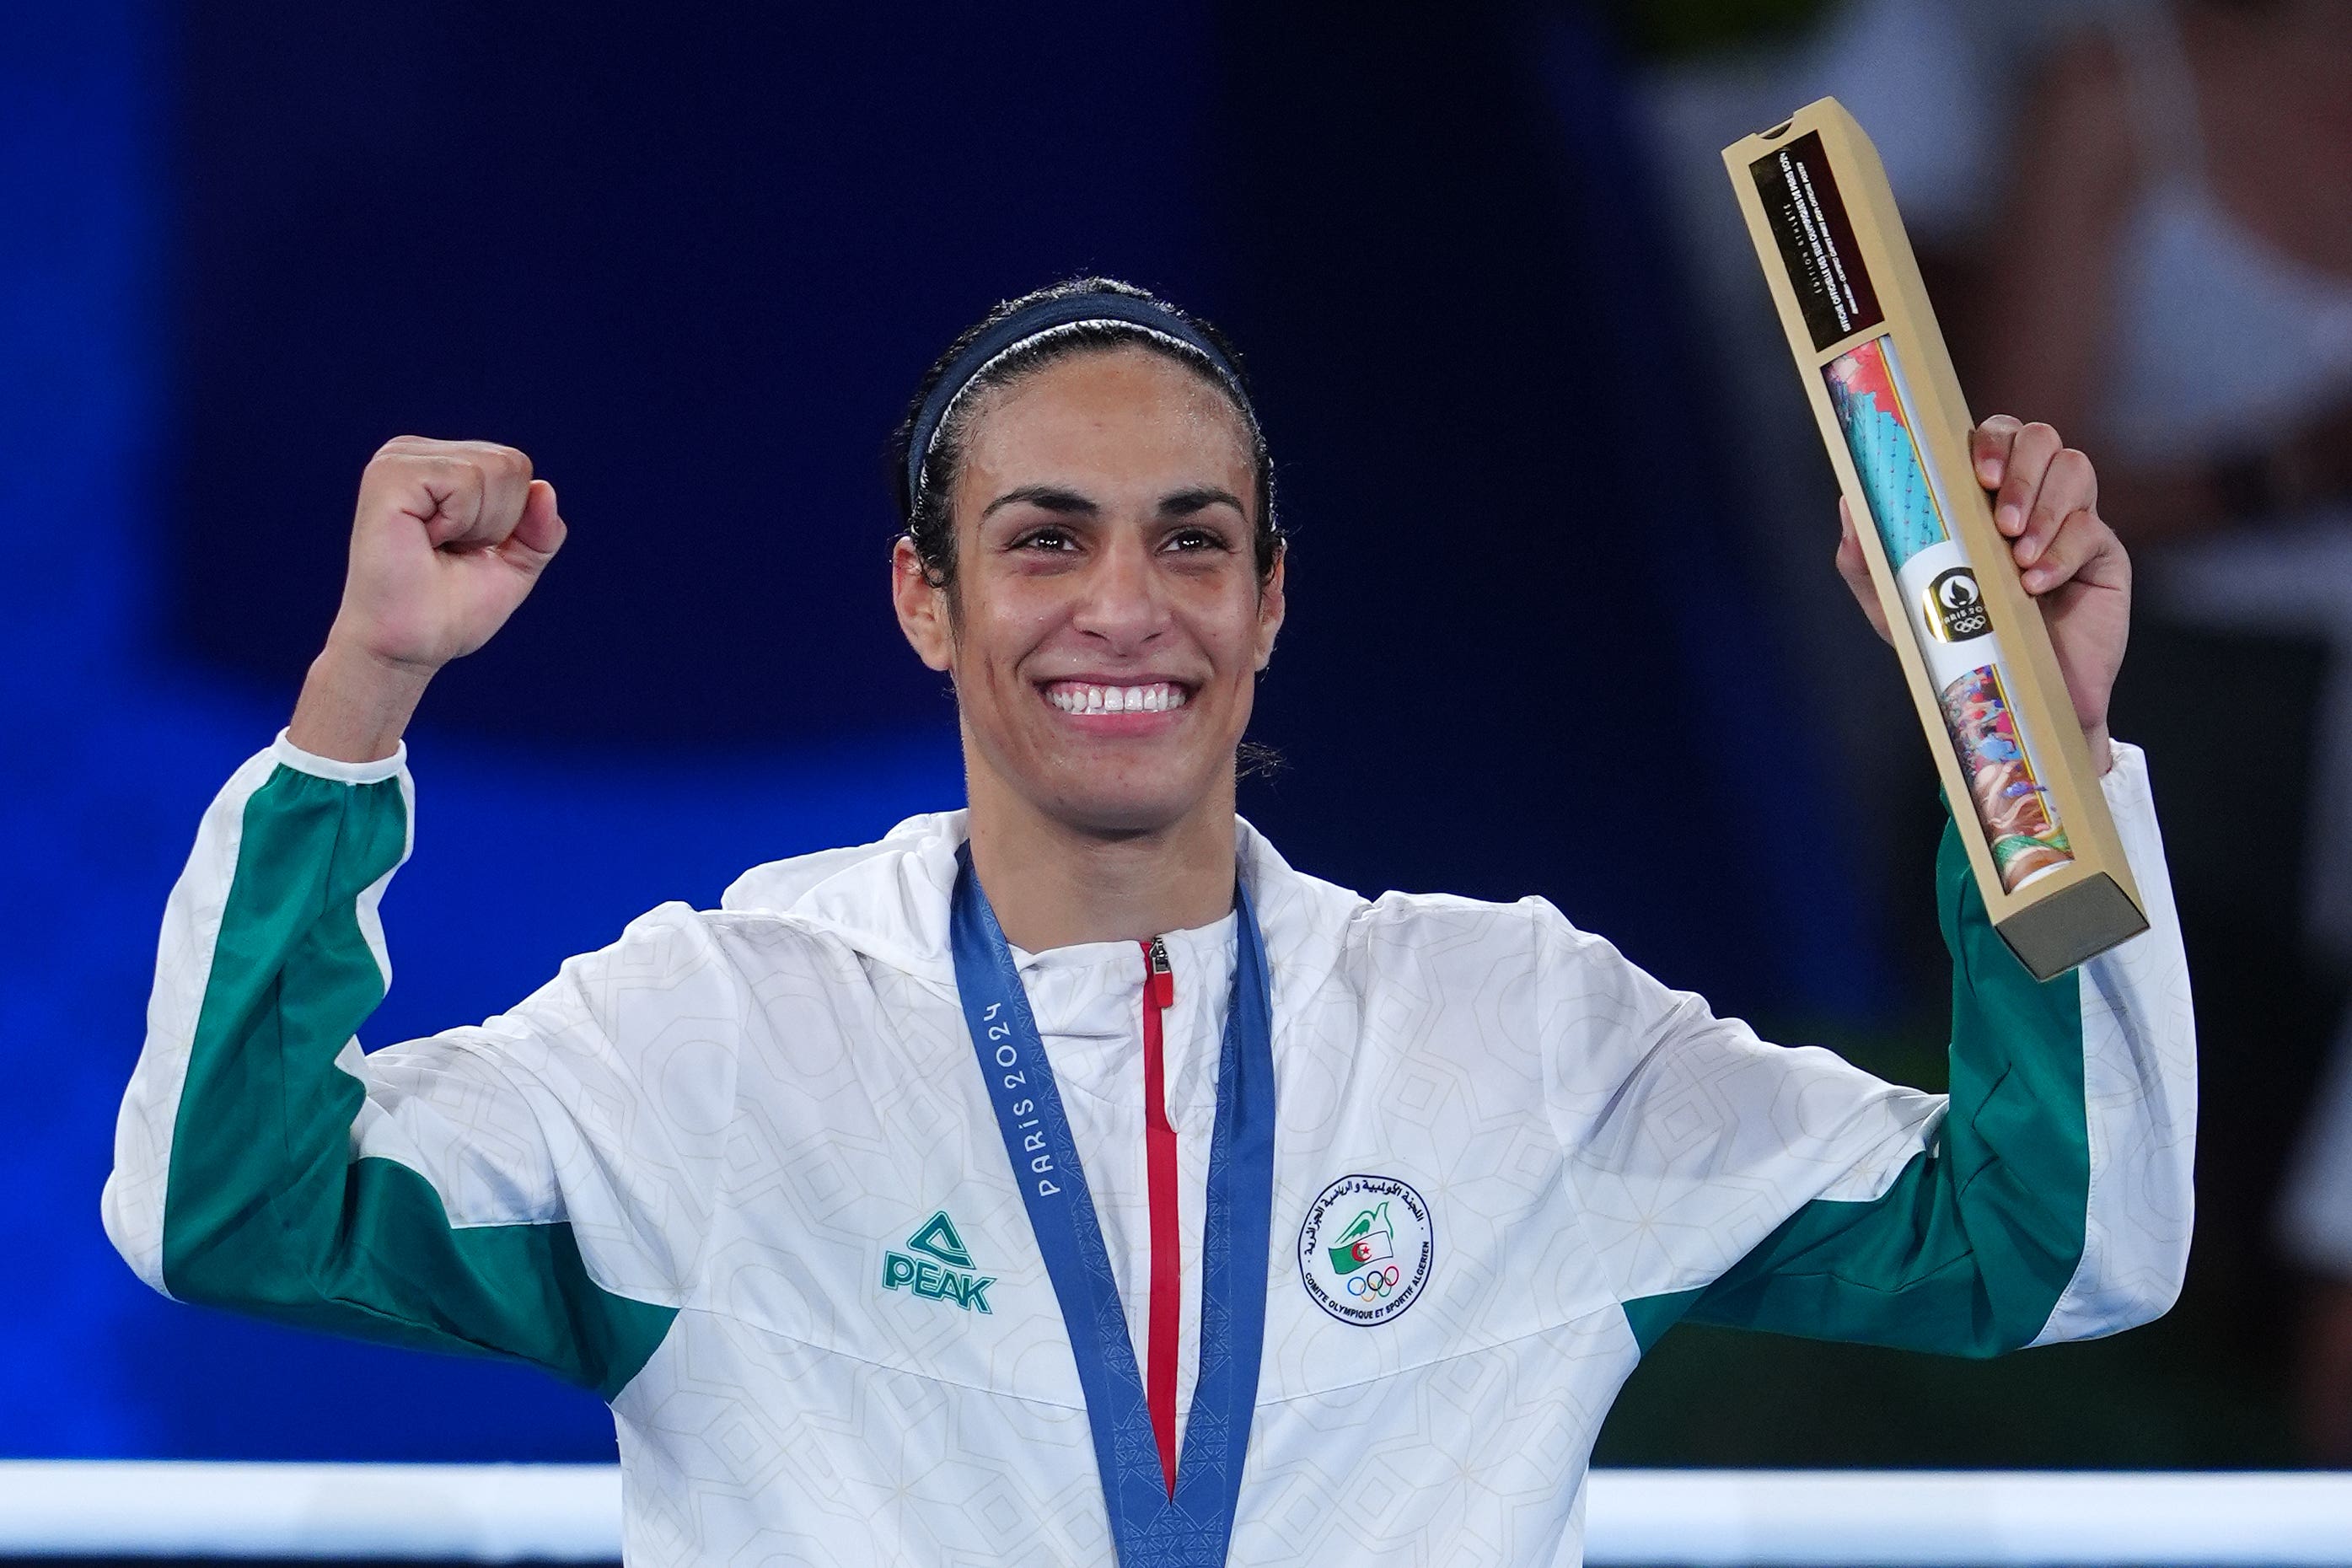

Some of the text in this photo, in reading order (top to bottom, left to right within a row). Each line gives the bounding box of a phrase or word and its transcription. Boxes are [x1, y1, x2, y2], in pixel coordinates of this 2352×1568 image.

[983, 1002, 1028, 1089] 2024
[1304, 1206, 1325, 1255] الجزائرية
[1402, 1191, 1424, 1222] اللجنة
[883, 1250, 998, 1315] PEAK
[1305, 1241, 1430, 1319] COMITE OLYMPIQUE ET SPORTIF ALGERIEN
